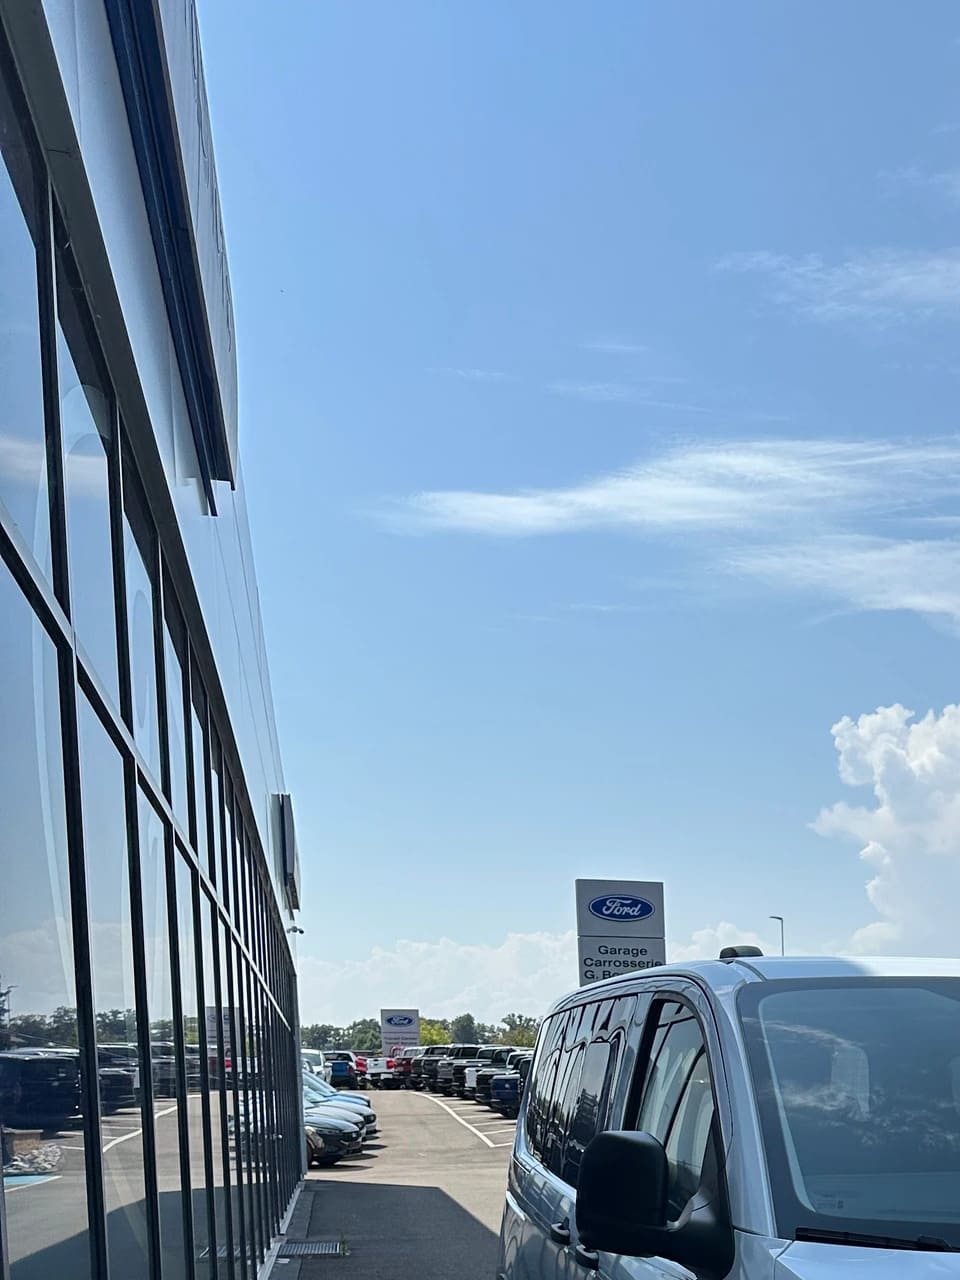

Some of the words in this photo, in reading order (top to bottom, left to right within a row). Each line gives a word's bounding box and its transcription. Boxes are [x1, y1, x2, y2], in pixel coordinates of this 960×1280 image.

[602, 898, 642, 916] Ford
[598, 945, 648, 958] Garage
[583, 957, 663, 969] Carrosserie
[584, 969, 599, 980] G.
